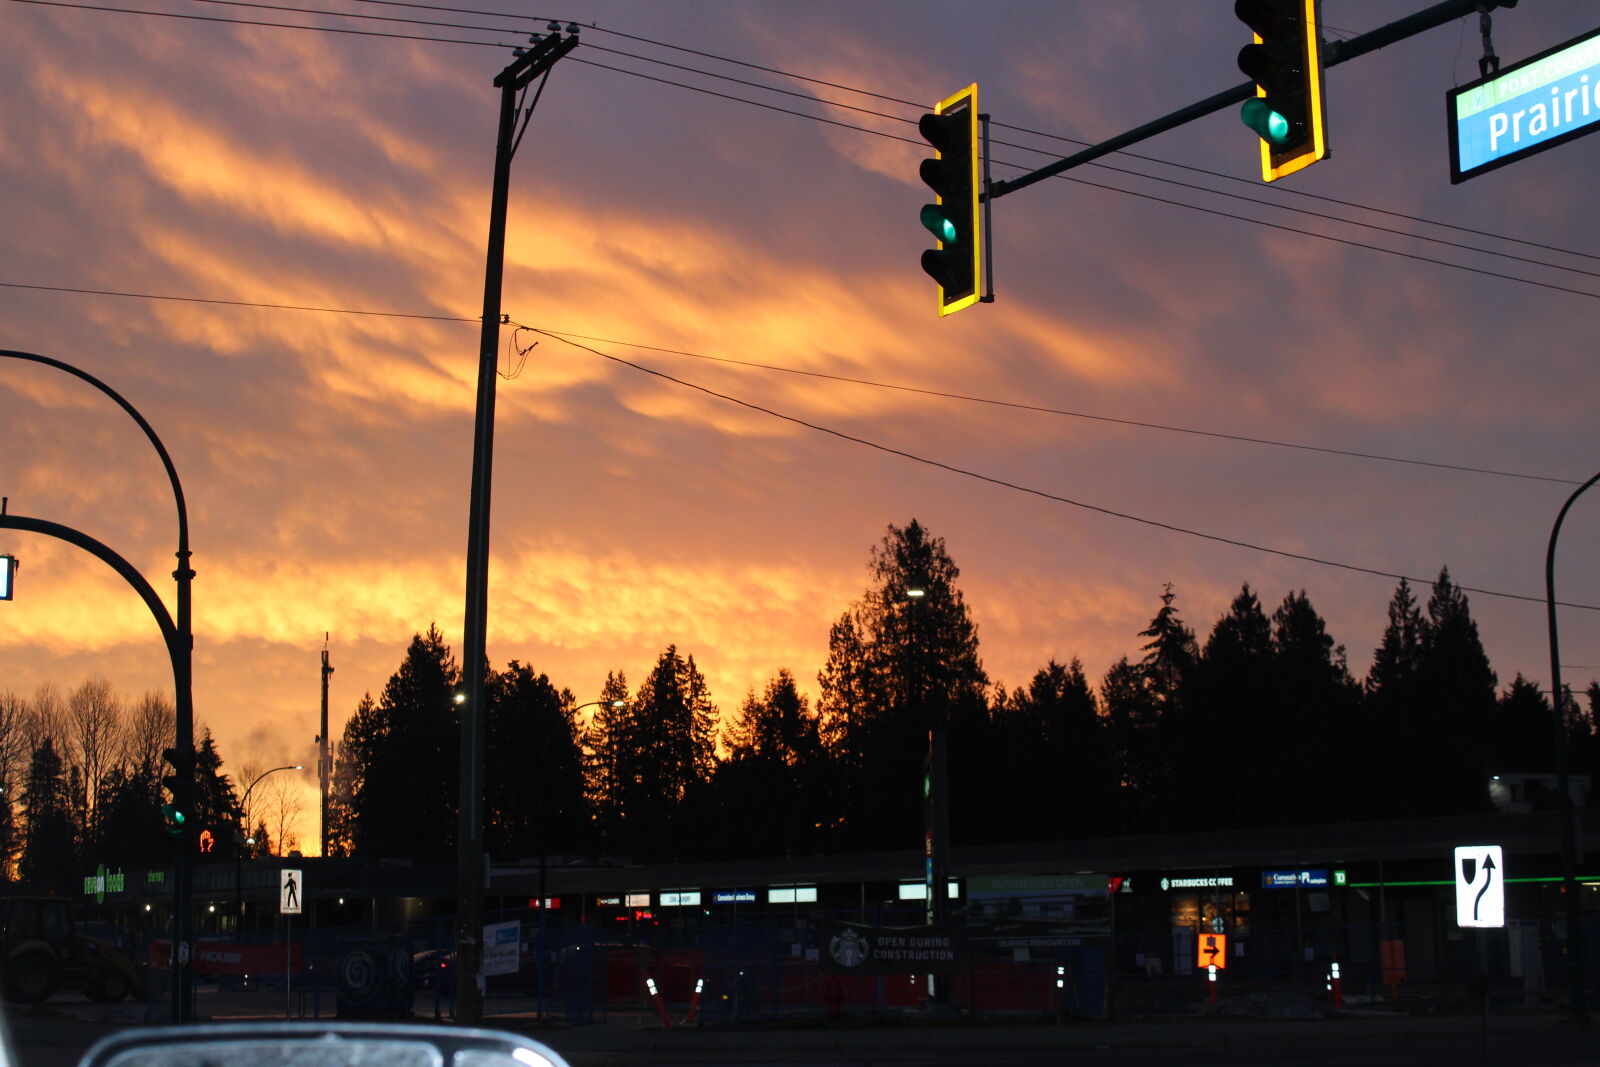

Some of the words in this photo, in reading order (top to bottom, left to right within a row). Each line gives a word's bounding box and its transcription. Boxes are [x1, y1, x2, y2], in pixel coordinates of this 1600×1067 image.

[1499, 69, 1540, 98] PORT
[1055, 878, 1085, 888] OPEN
[1171, 878, 1208, 888] STARBUCKS
[878, 937, 906, 947] OPEN
[910, 937, 949, 947] DURING
[1030, 938, 1082, 947] RENOVATION
[873, 949, 955, 960] CONSTRUCTION
